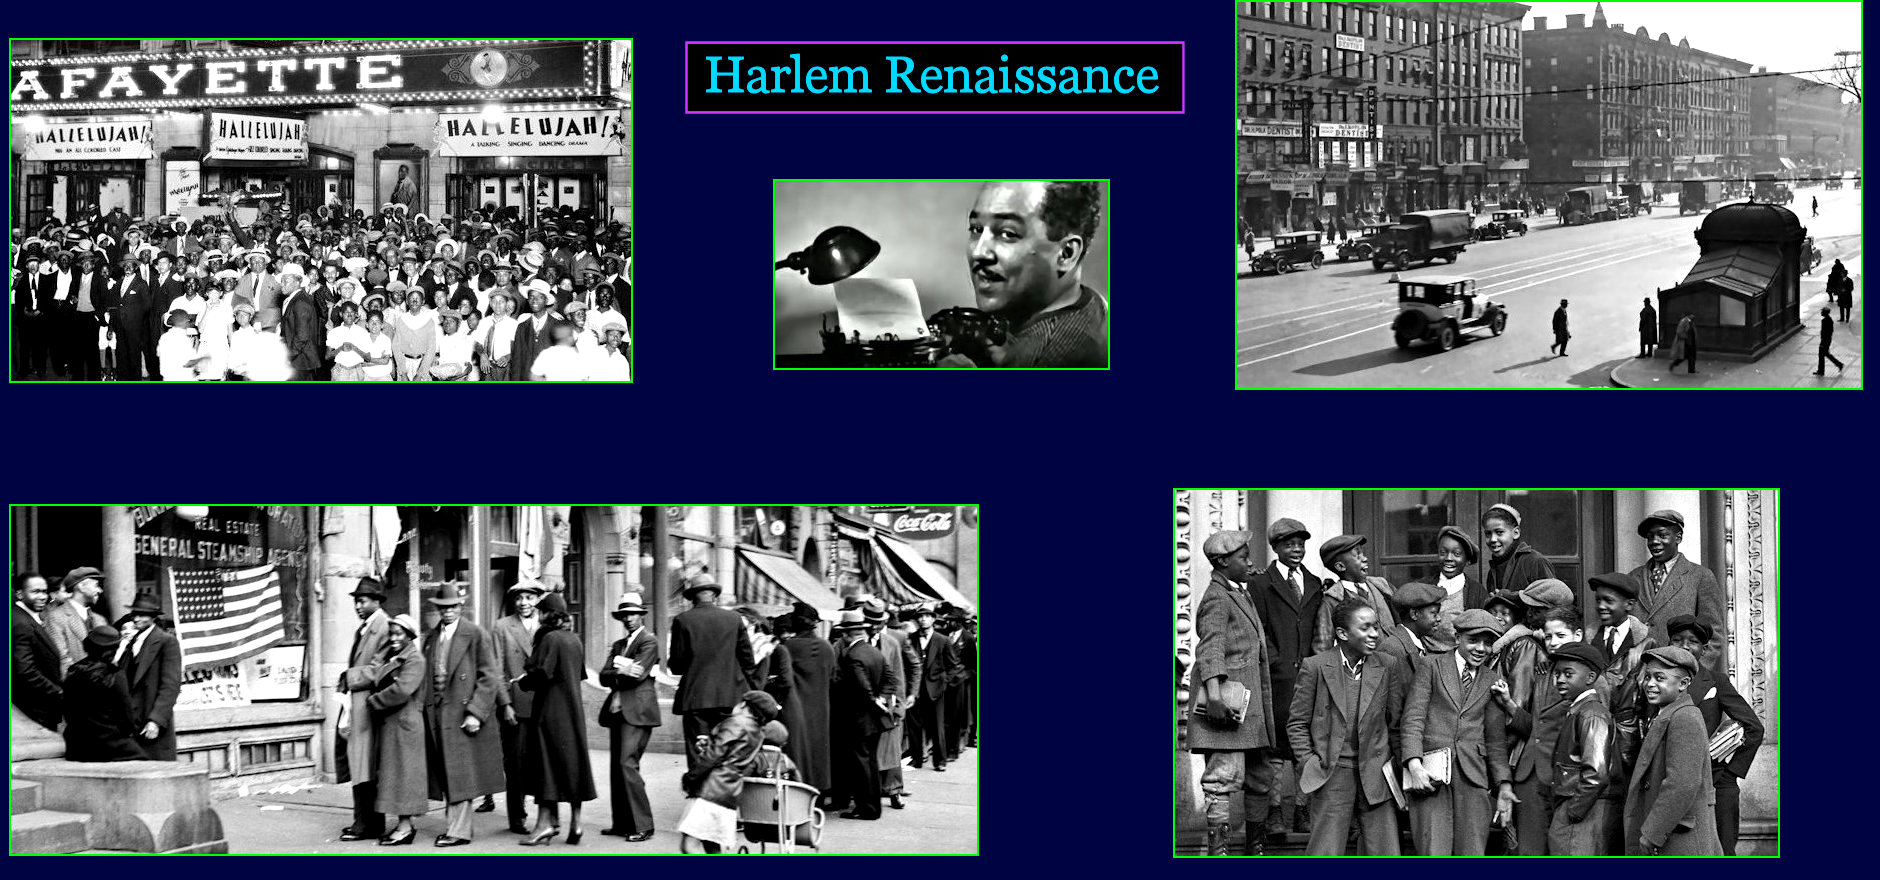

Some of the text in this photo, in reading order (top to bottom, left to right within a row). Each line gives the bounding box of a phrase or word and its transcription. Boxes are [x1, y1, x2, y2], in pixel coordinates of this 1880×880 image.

[219, 118, 300, 140] HALLELUJAH
[447, 115, 609, 138] HALLELUJAH!
[1335, 129, 1369, 137] DENTIST
[194, 516, 260, 537] REAL ESTATE
[133, 534, 195, 560] GENERAL
[197, 541, 264, 565] STEAMSHIP
